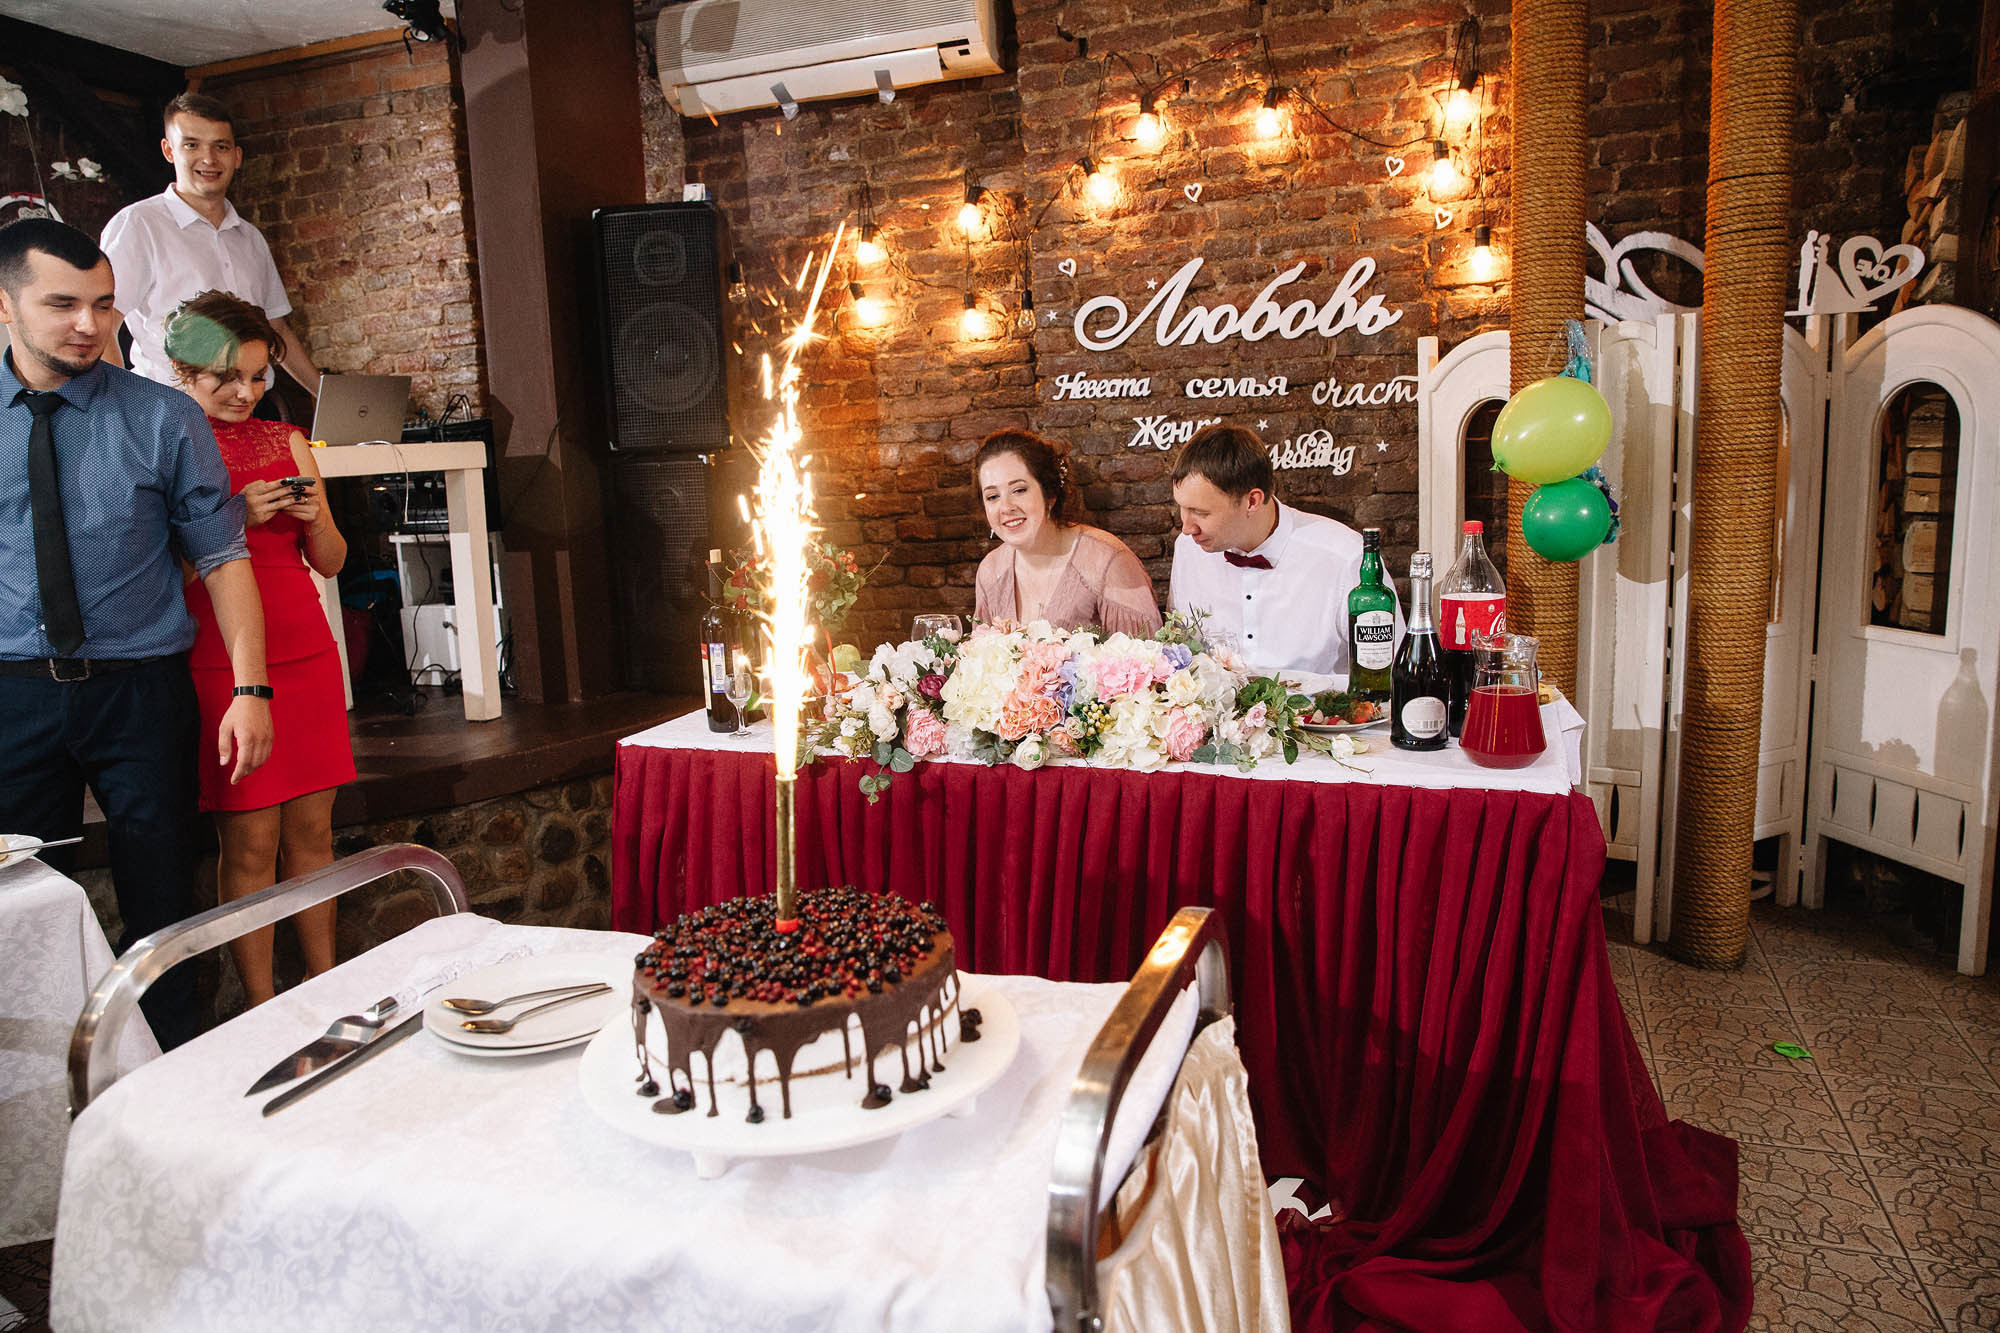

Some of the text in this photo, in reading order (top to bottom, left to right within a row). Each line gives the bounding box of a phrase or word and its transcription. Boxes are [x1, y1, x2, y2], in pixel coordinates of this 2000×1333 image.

[1074, 256, 1403, 351] Любовь
[1052, 371, 1152, 400] Невеста
[1185, 376, 1290, 399] семья
[1311, 375, 1419, 408] счаст
[1360, 626, 1391, 635] WILLIAM
